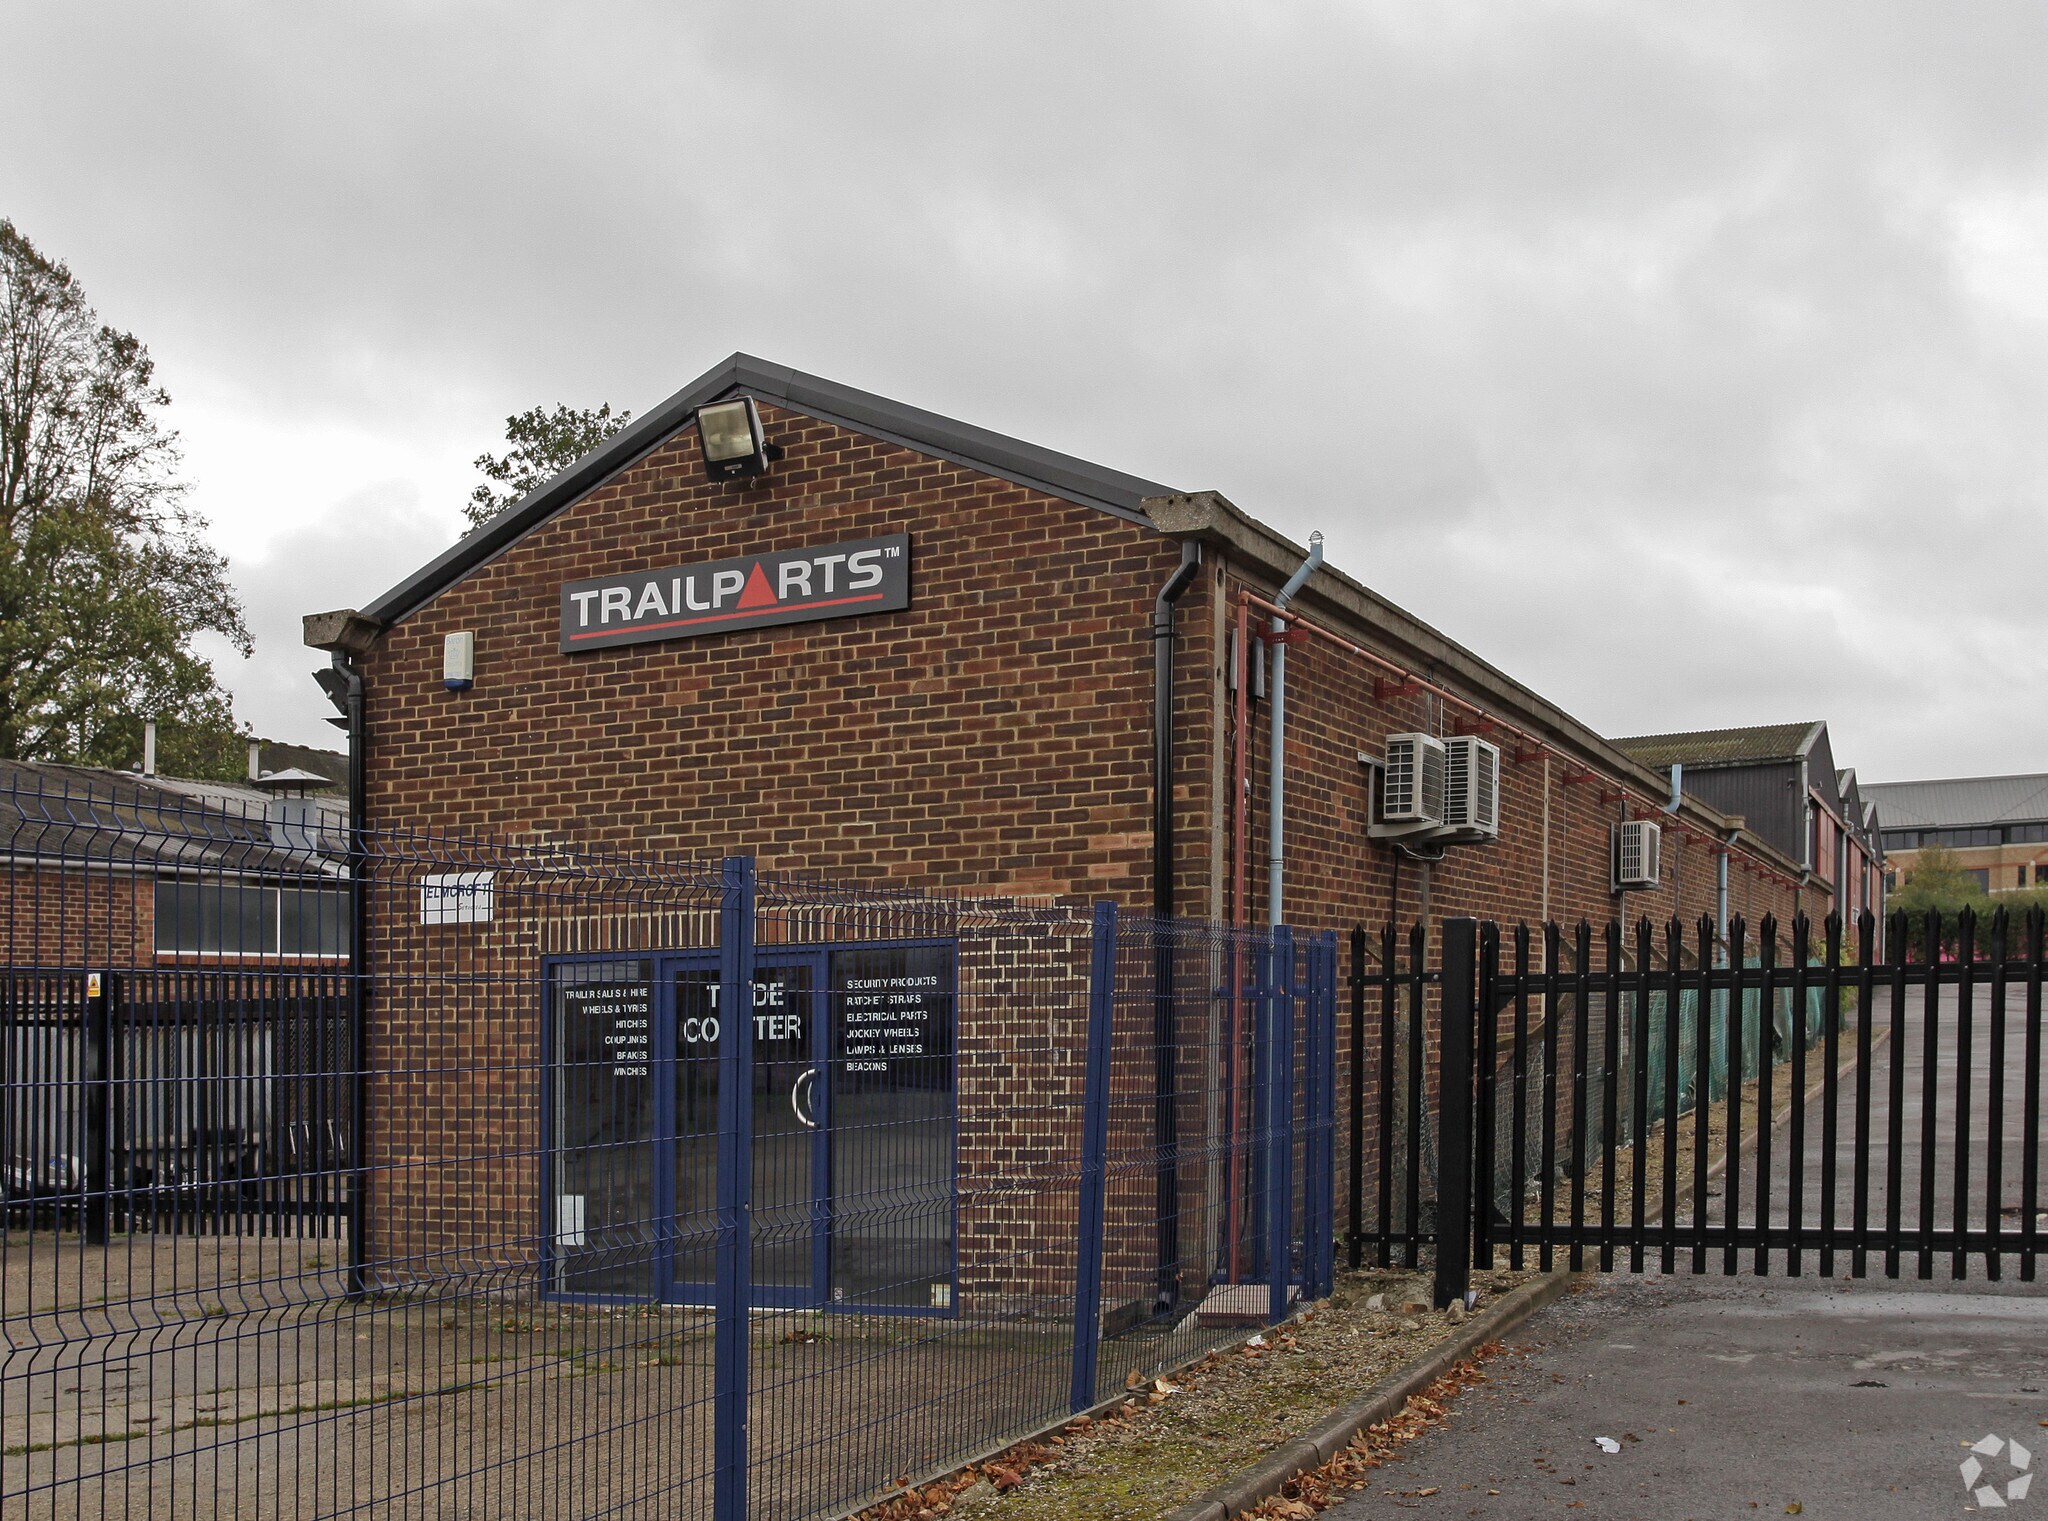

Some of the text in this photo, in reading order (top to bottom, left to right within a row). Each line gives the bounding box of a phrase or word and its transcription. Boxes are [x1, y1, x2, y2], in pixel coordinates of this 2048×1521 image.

[570, 548, 884, 627] TRAILPARTS
[847, 976, 937, 989] SECURITY PRODUCTS
[706, 982, 784, 1008] TDE
[847, 1012, 897, 1022] ELECTRICAL
[615, 1019, 648, 1029] HITCHES
[683, 1014, 801, 1043] COTER
[847, 1027, 920, 1039] JOCKEY WHEELS
[889, 1044, 923, 1054] LENSES
[846, 1062, 887, 1071] BEACONS
